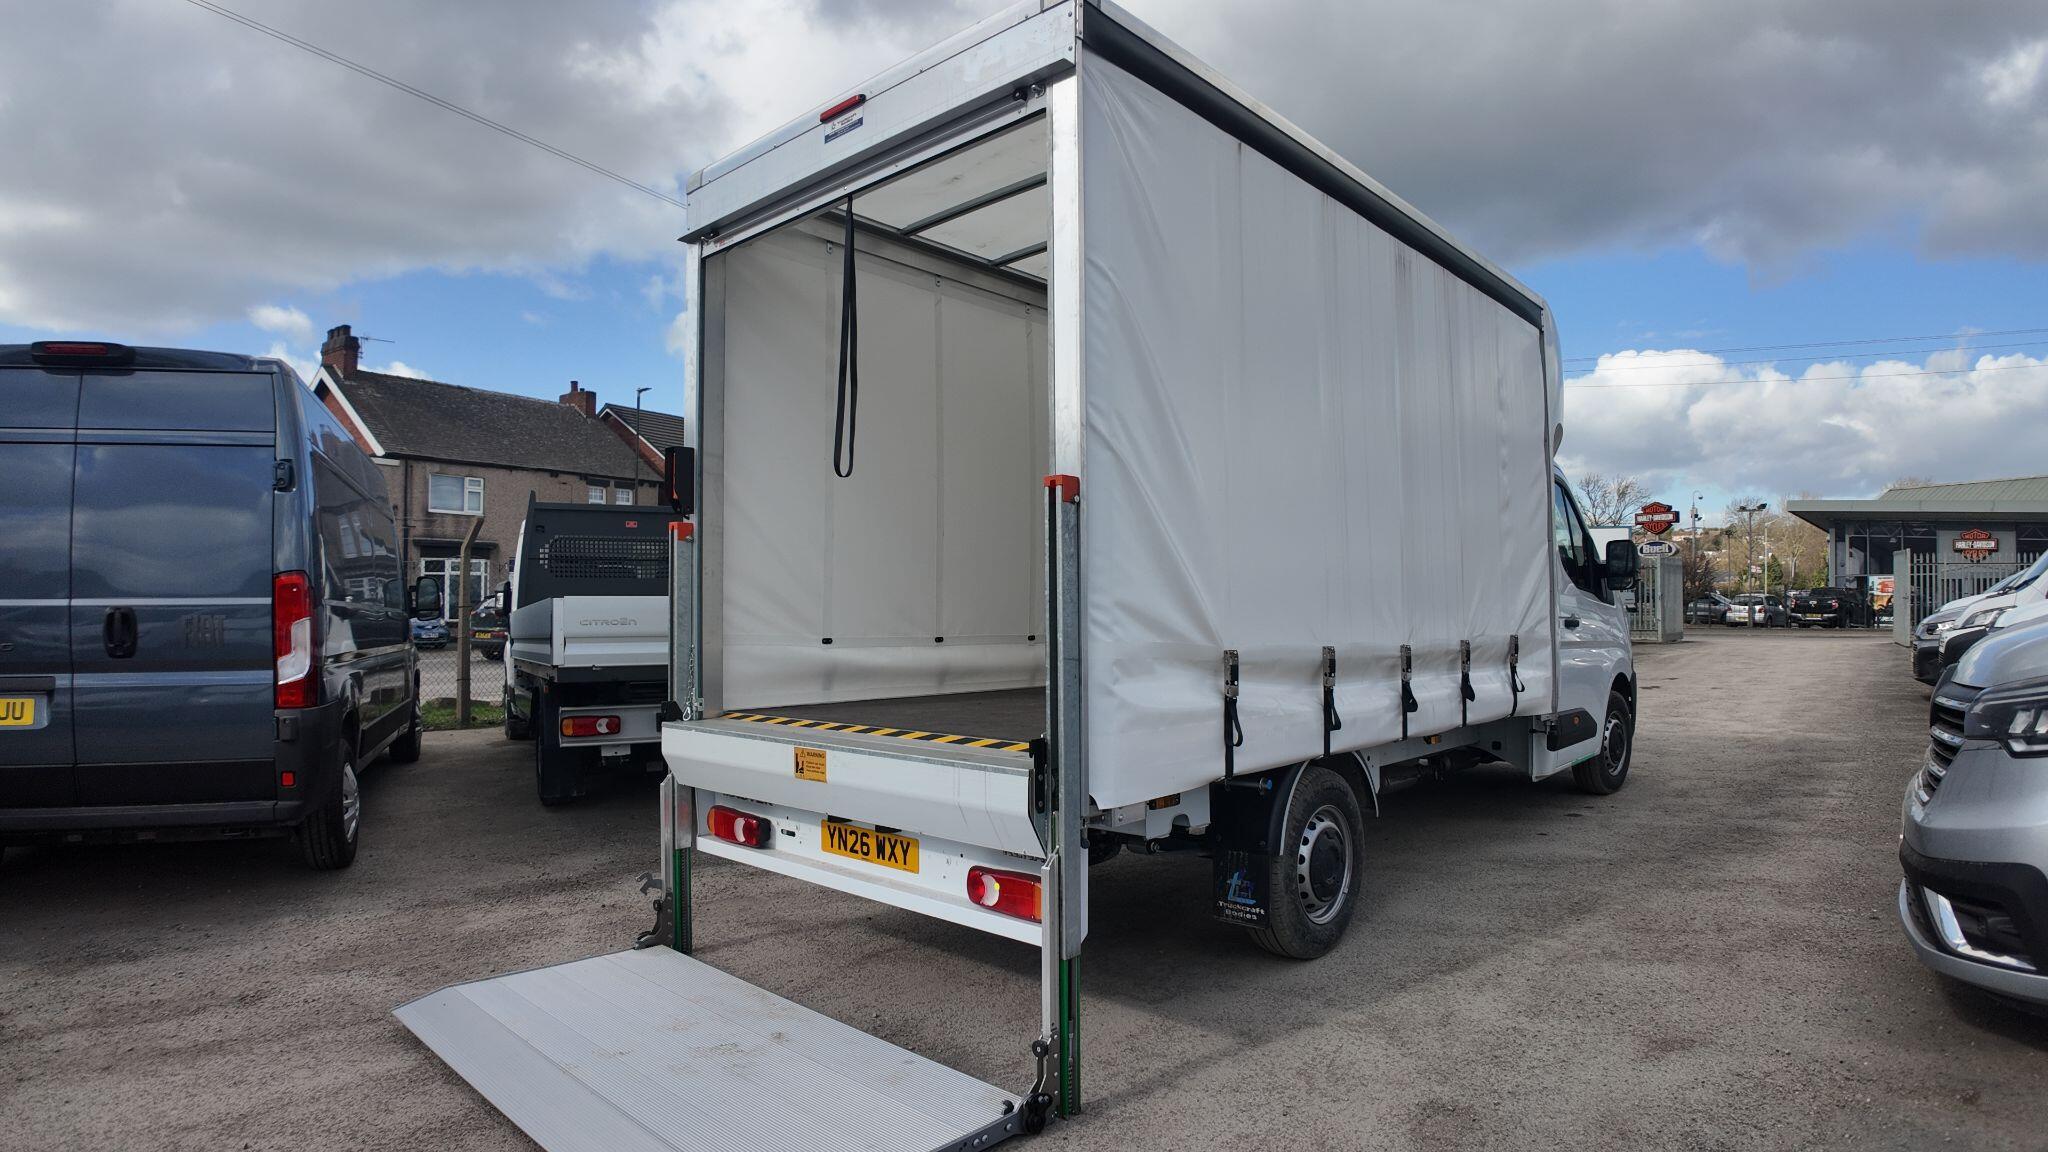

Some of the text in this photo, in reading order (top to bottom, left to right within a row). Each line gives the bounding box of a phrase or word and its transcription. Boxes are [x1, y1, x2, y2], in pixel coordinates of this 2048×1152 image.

[1642, 543, 1669, 554] Buell
[1955, 541, 1995, 549] HARLEY-DAVIDSON
[827, 824, 911, 866] YN26 WXY
[1218, 900, 1265, 915] Truckcraft
